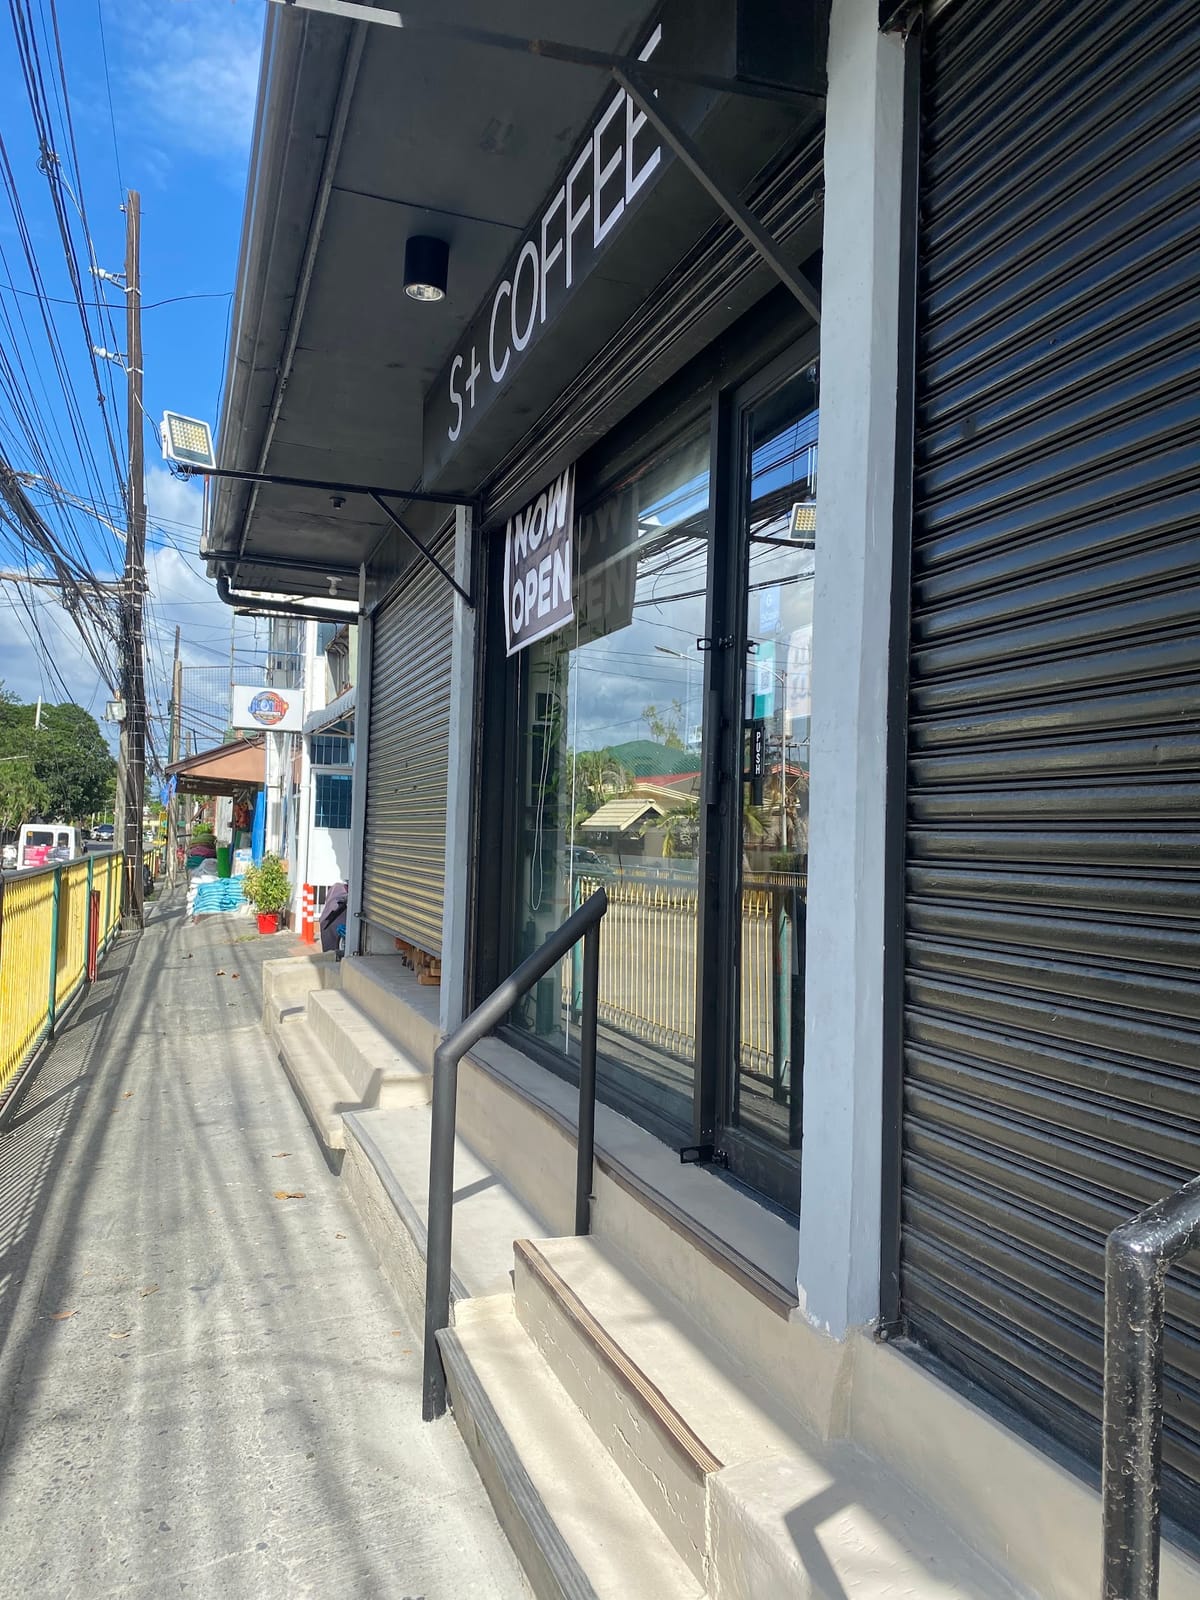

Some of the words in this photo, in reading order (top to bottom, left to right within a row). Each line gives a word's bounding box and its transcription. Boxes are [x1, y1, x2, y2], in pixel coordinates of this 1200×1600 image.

[488, 23, 662, 383] COFFEE
[514, 466, 570, 565] NOW
[512, 540, 571, 634] OPEN
